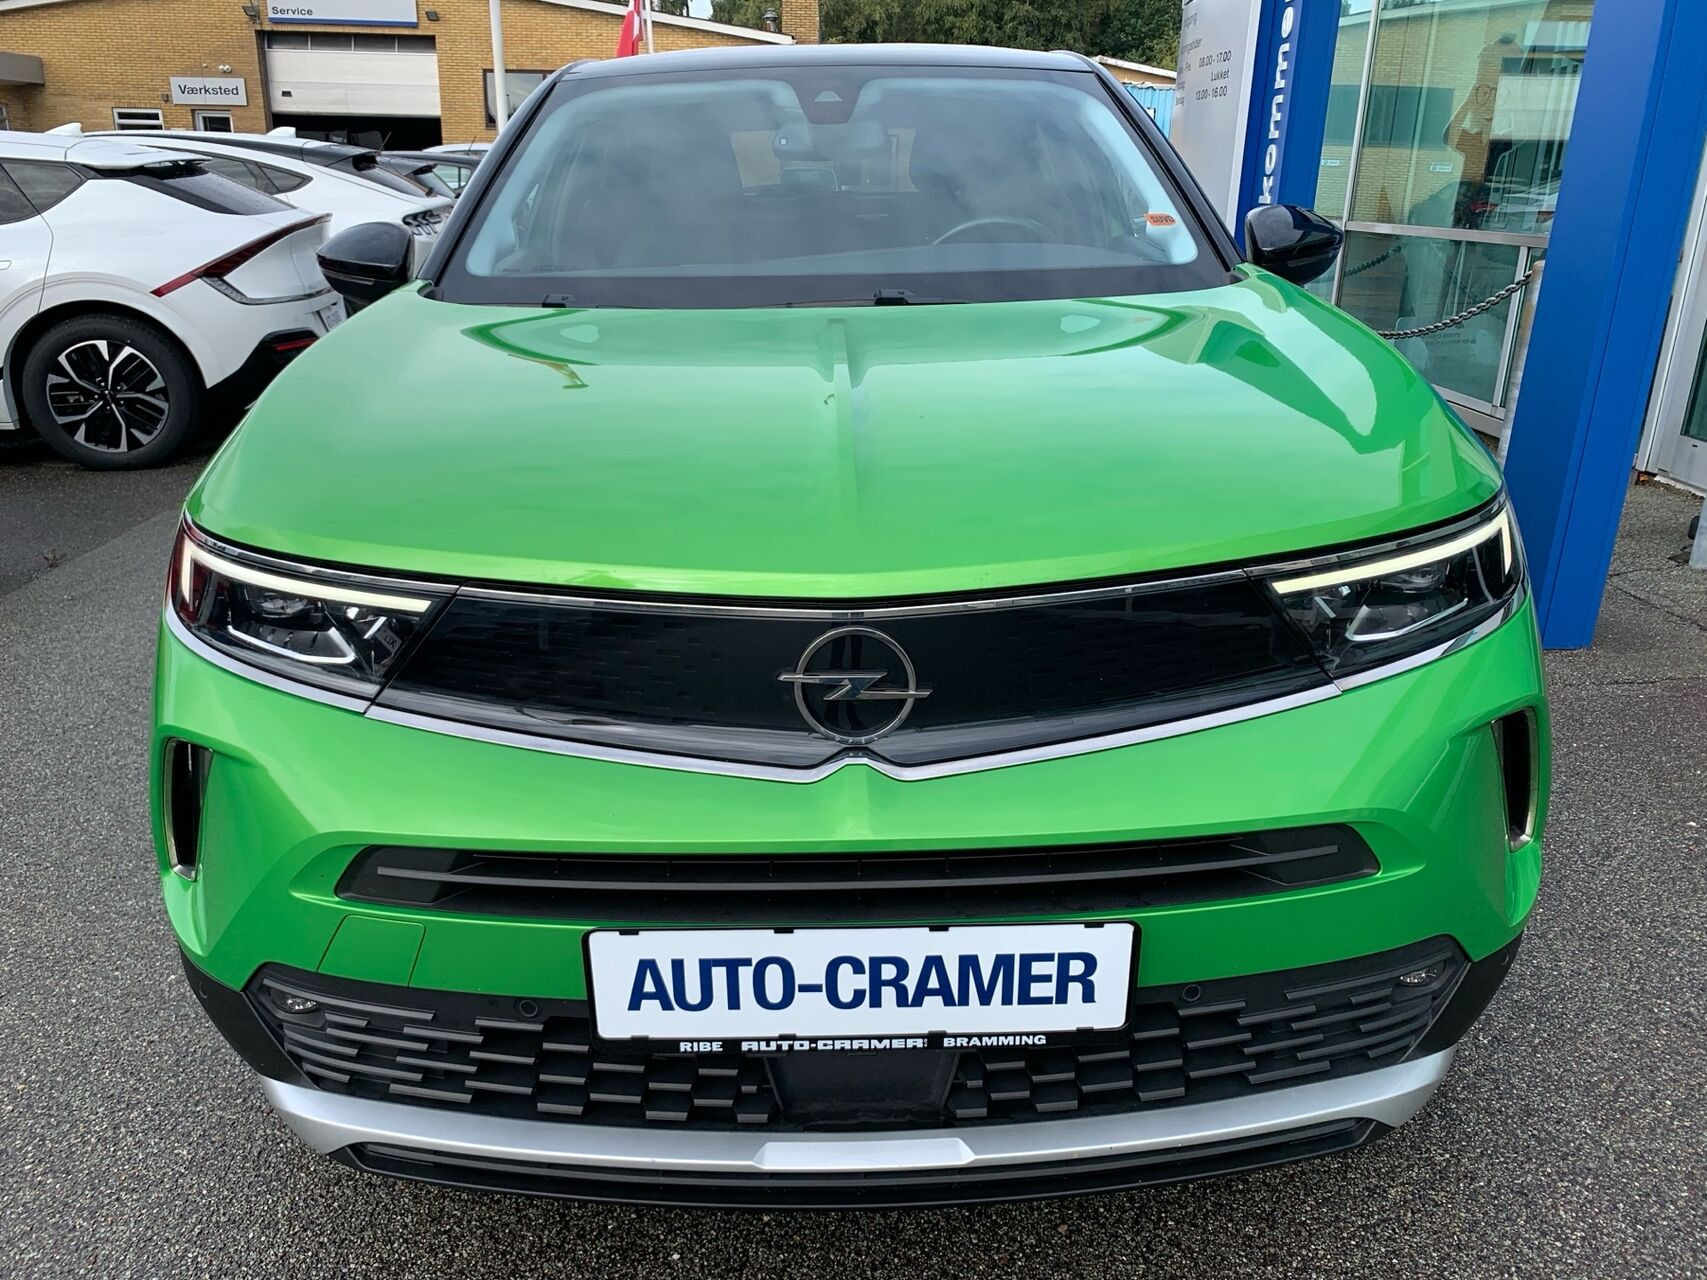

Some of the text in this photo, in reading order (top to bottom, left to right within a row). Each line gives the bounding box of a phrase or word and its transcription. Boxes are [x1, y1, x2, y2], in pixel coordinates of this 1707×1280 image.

[271, 6, 313, 16] Service
[1210, 69, 1230, 81] Lukket
[178, 84, 239, 96] Værksted
[1258, 0, 1294, 204] komme
[627, 951, 1097, 1012] AUTO-CRAMER
[679, 1041, 723, 1052] RIBE
[741, 1038, 923, 1051] AUTO-CRAMER
[943, 1034, 1047, 1048] BRAMMING
